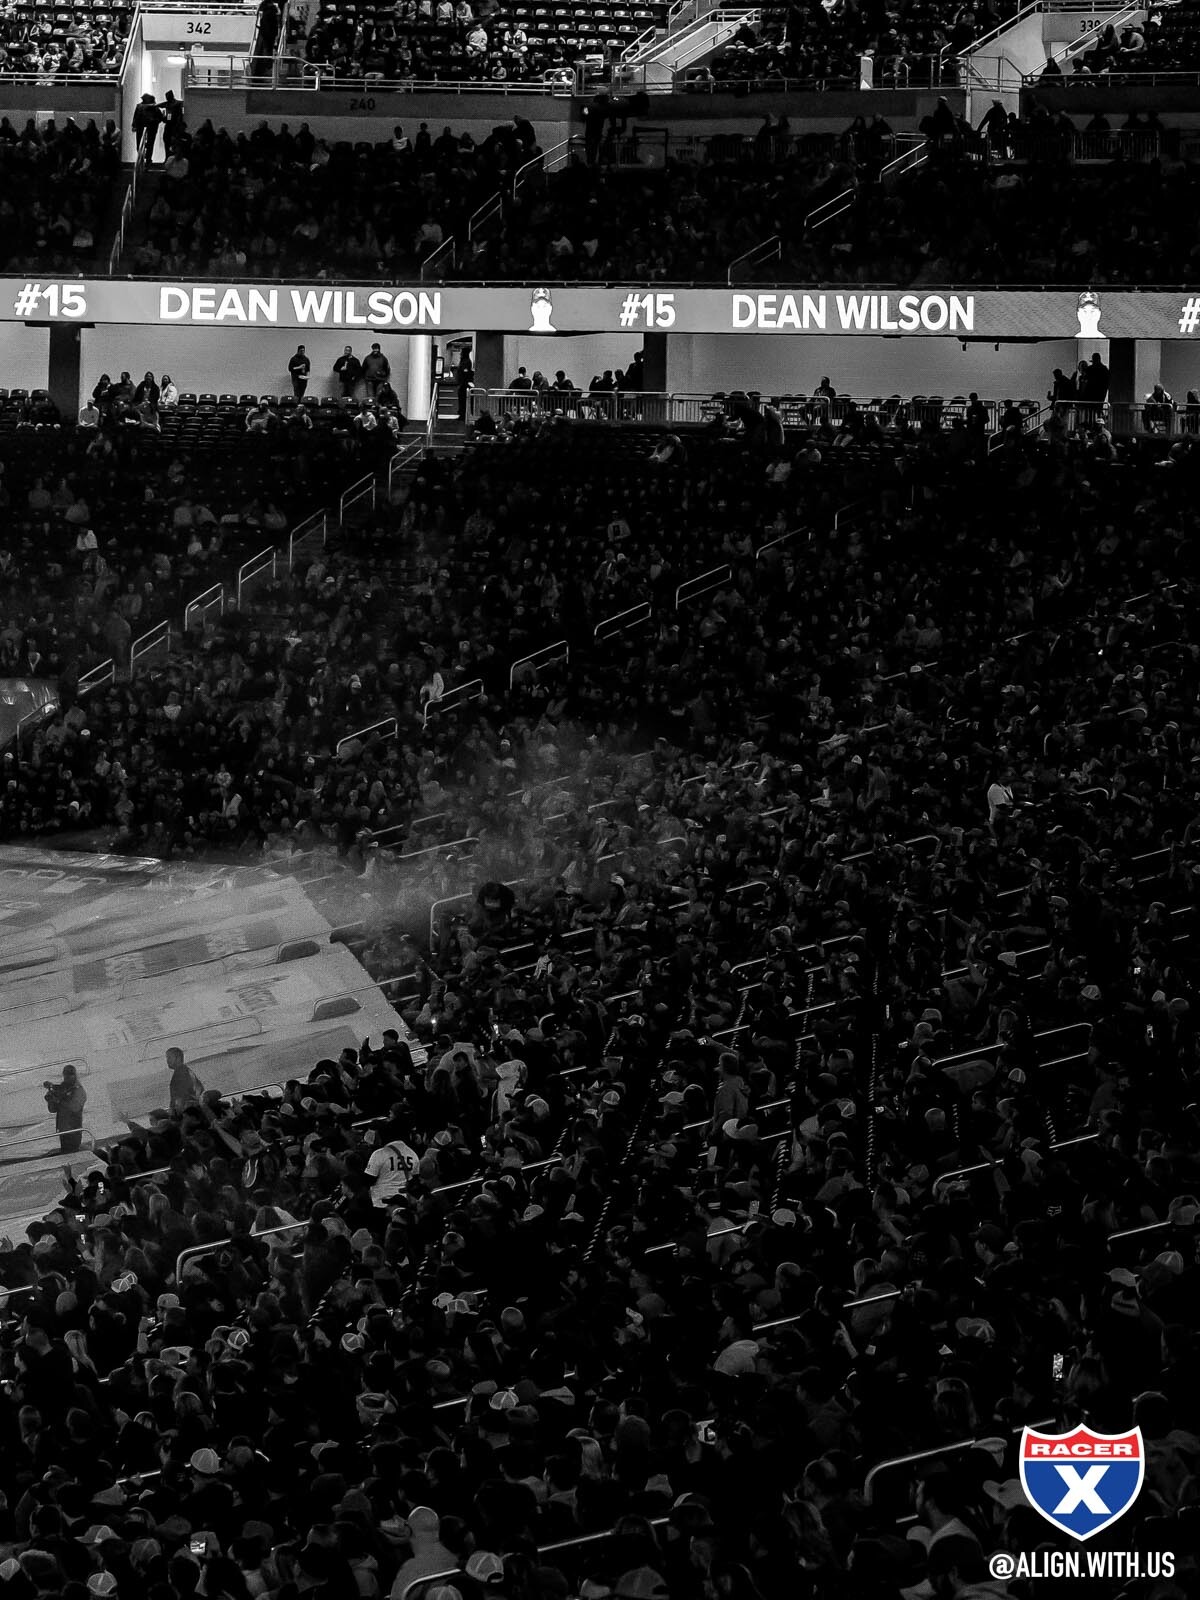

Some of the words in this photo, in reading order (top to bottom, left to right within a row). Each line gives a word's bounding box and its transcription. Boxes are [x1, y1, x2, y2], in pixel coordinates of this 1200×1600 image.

[186, 21, 212, 36] 342
[349, 97, 376, 112] 240
[14, 282, 88, 318] #15
[158, 286, 279, 322] DEAN
[290, 289, 442, 326] WILSON
[618, 293, 676, 328] #15
[731, 294, 827, 330] DEAN
[836, 295, 975, 332] WILSON
